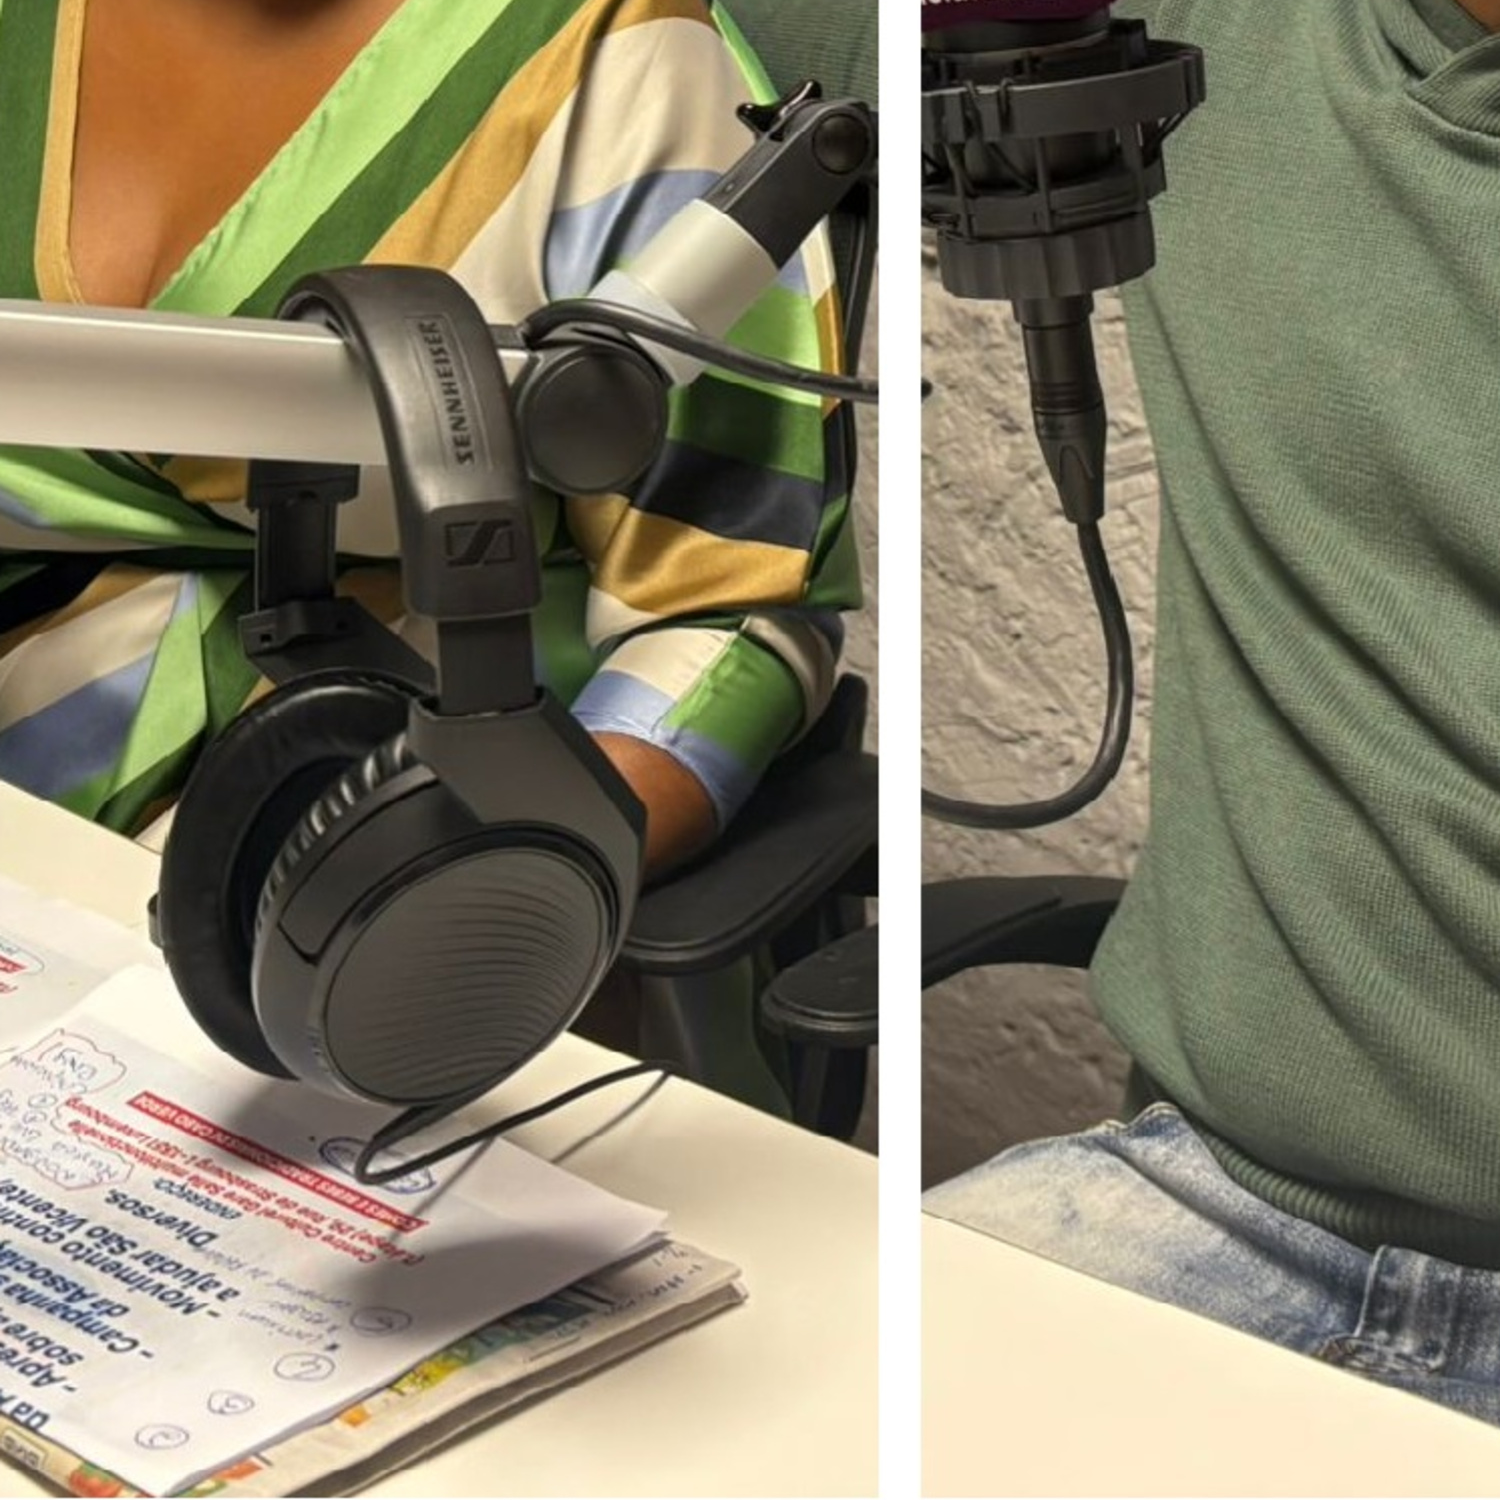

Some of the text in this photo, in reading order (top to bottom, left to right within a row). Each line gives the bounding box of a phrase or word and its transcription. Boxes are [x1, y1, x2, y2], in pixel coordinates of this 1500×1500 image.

[418, 318, 475, 467] SENNHEISER
[222, 1191, 262, 1218] Gare
[256, 1207, 323, 1240] Culturel
[85, 1225, 139, 1257] São
[322, 1233, 378, 1265] Centre
[61, 1240, 210, 1315] Movimento
[131, 1248, 222, 1295] ajudar
[3, 1281, 141, 1353] Campanha
